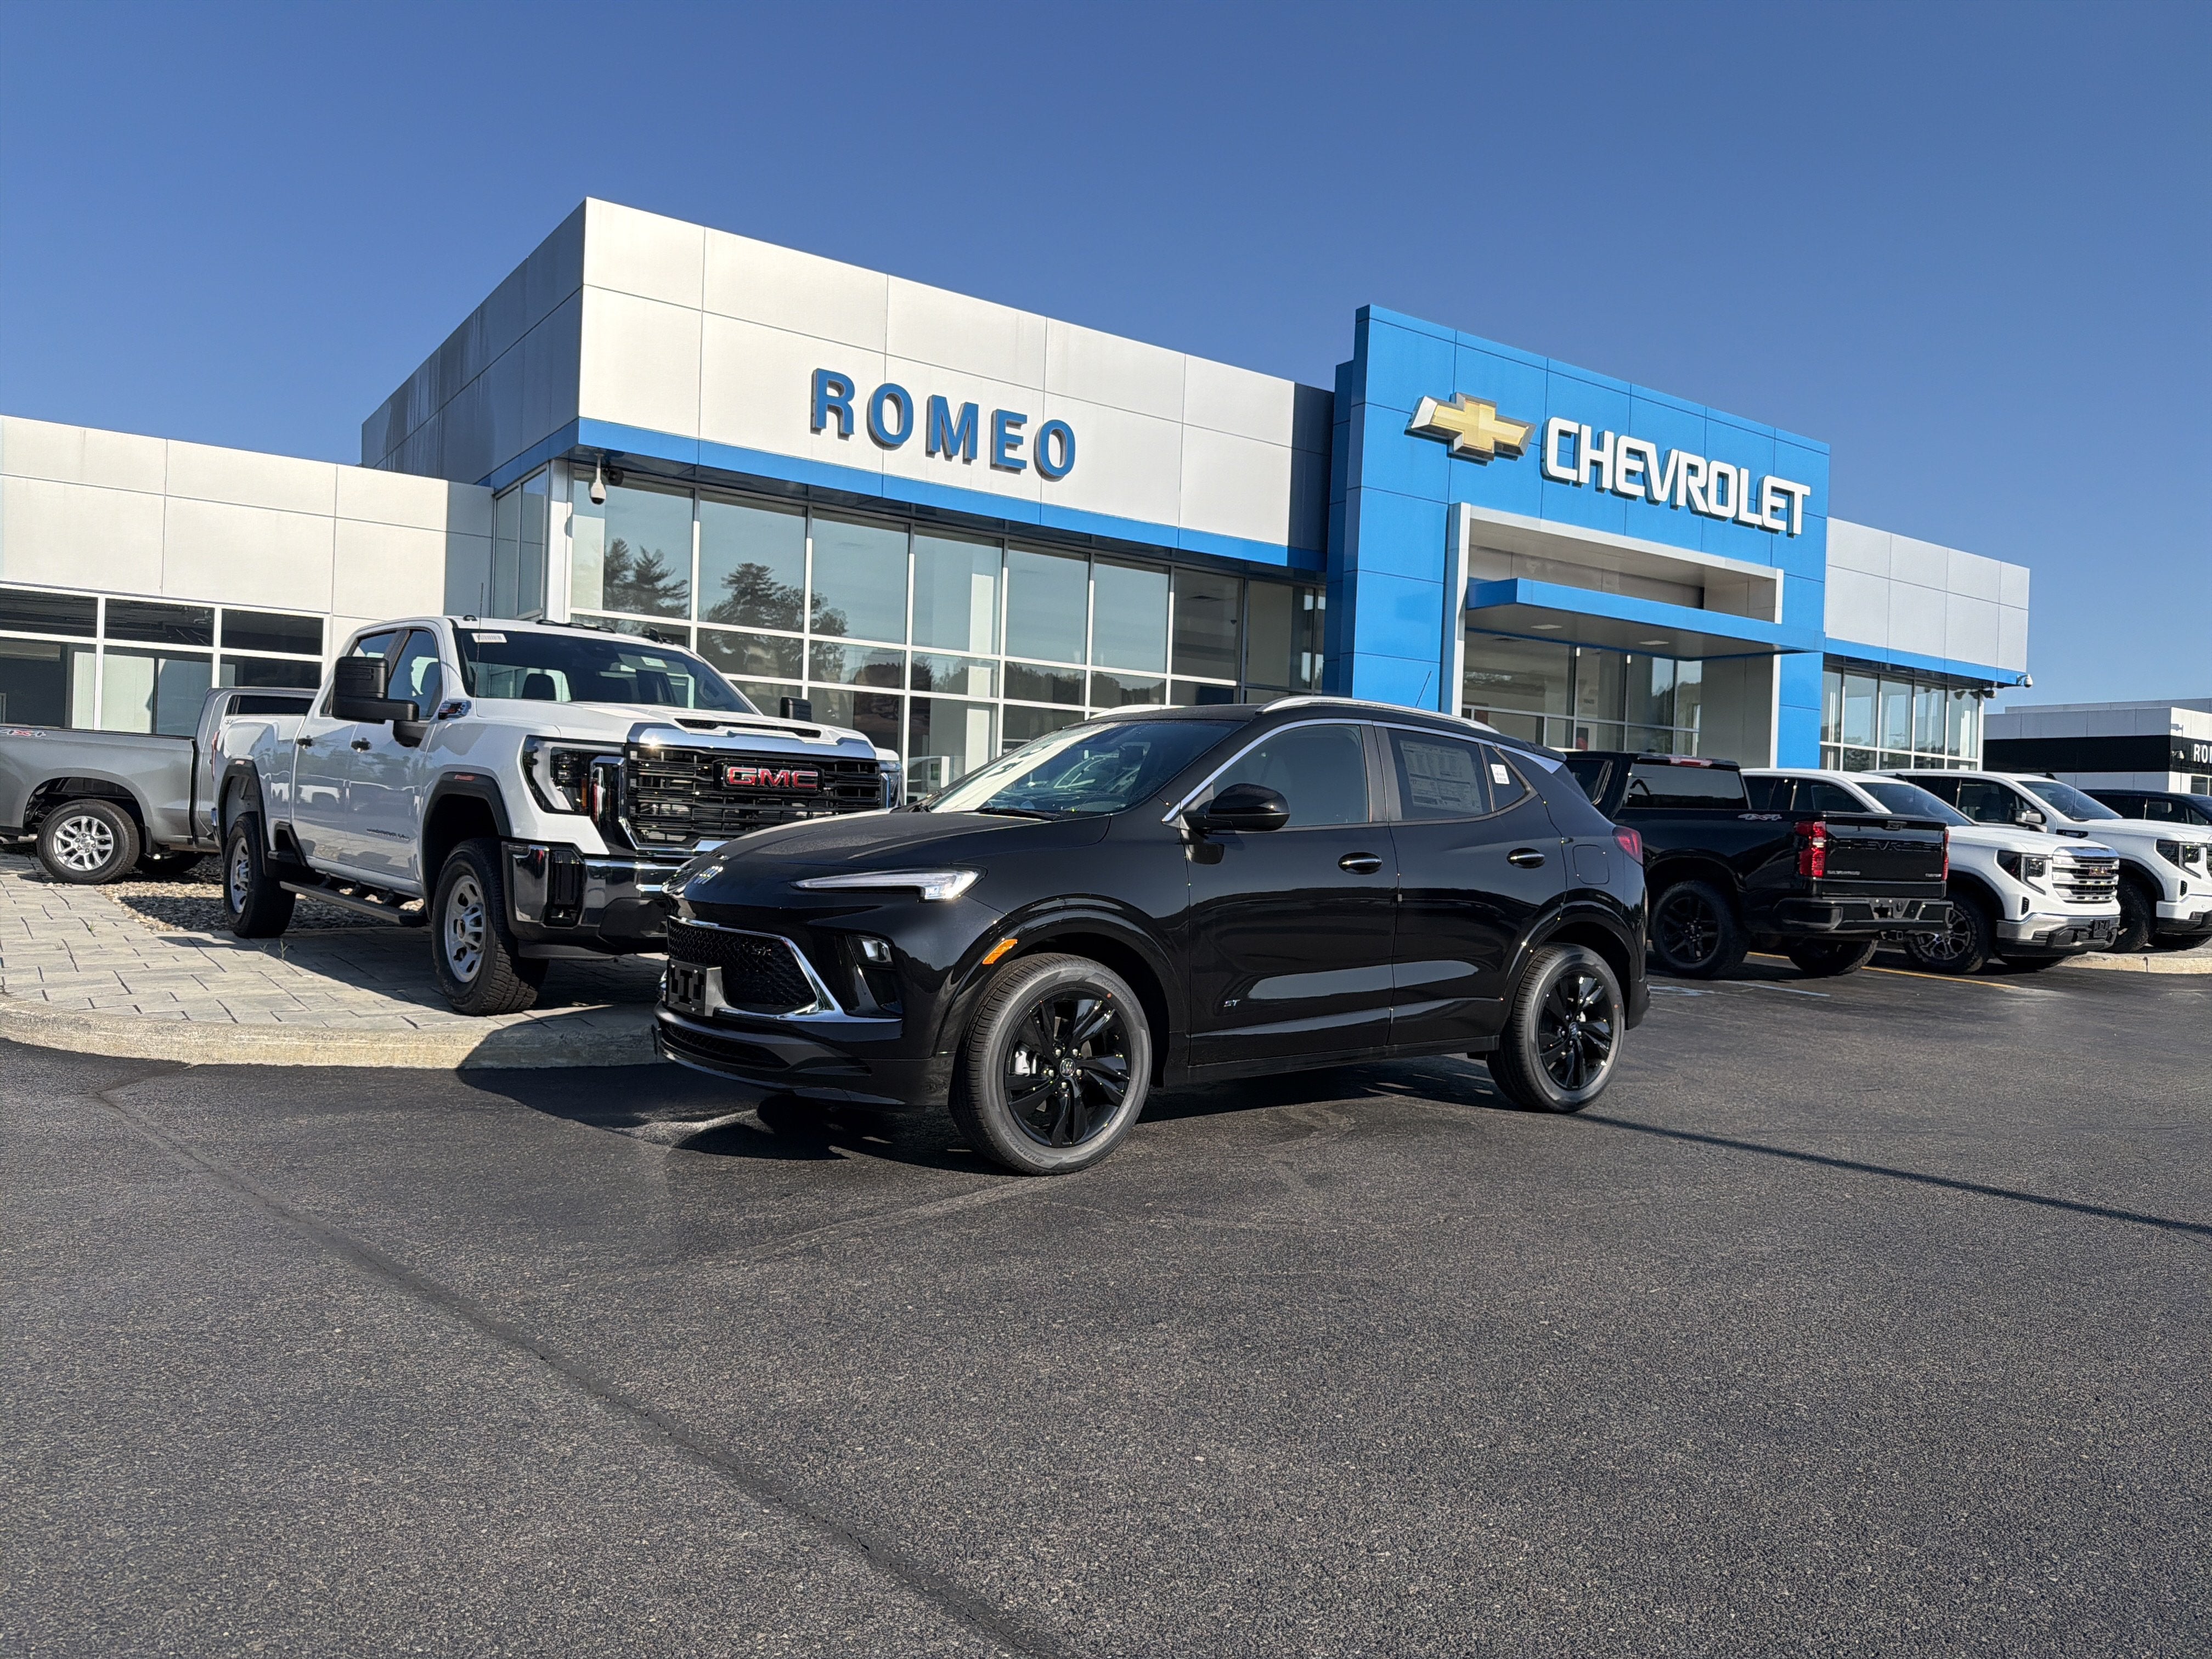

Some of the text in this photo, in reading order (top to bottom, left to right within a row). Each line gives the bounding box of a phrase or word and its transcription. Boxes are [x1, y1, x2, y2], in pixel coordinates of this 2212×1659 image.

[810, 368, 1076, 479] ROMEO
[1542, 416, 1811, 535] CHEVROLET
[2193, 743, 2212, 764] RO
[727, 766, 819, 788] GMC
[1223, 999, 1241, 1008] ST
